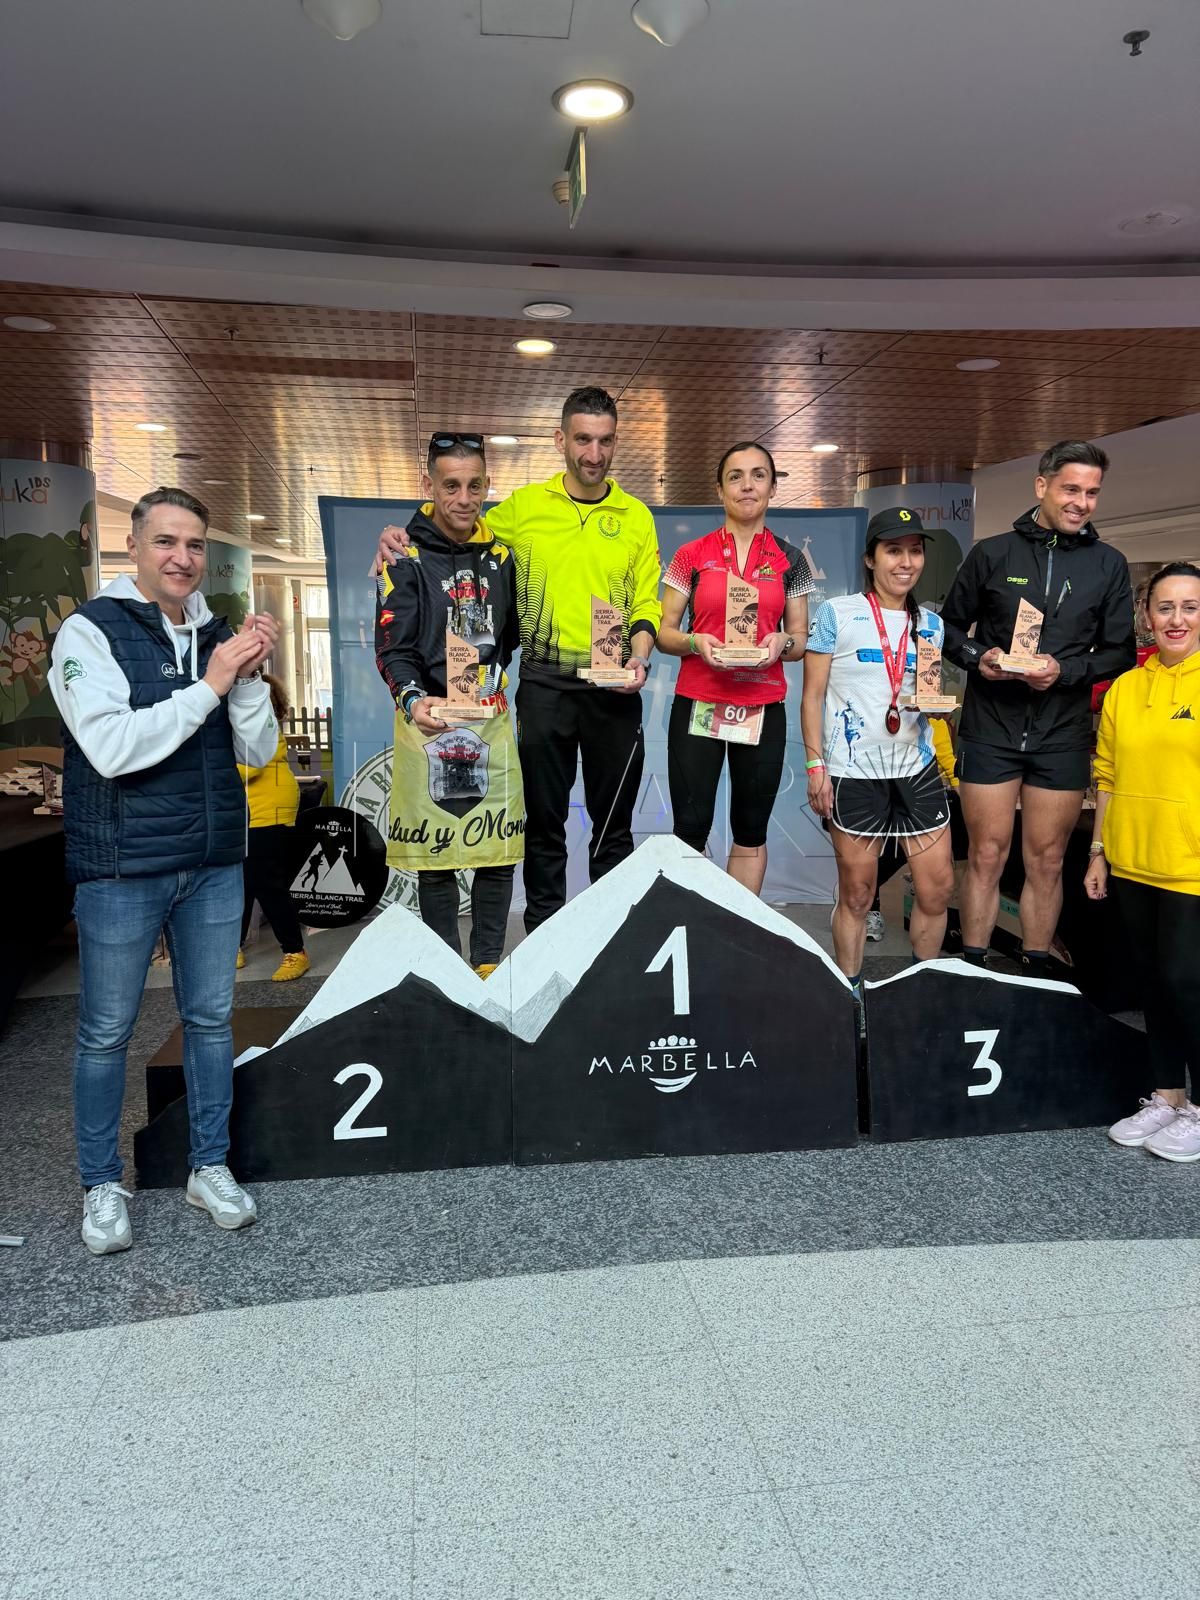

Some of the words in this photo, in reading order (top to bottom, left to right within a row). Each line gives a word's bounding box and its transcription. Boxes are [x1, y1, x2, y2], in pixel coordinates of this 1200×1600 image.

[0, 478, 48, 505] uka
[912, 500, 970, 521] anuka
[724, 705, 747, 722] 60
[315, 824, 352, 833] MARBELLA
[388, 817, 430, 844] lud
[430, 826, 455, 854] y
[463, 808, 526, 847] Mon
[645, 925, 690, 1015] 1
[588, 1050, 757, 1075] MARBELLA
[963, 1030, 1002, 1097] 3
[333, 1063, 387, 1140] 2
